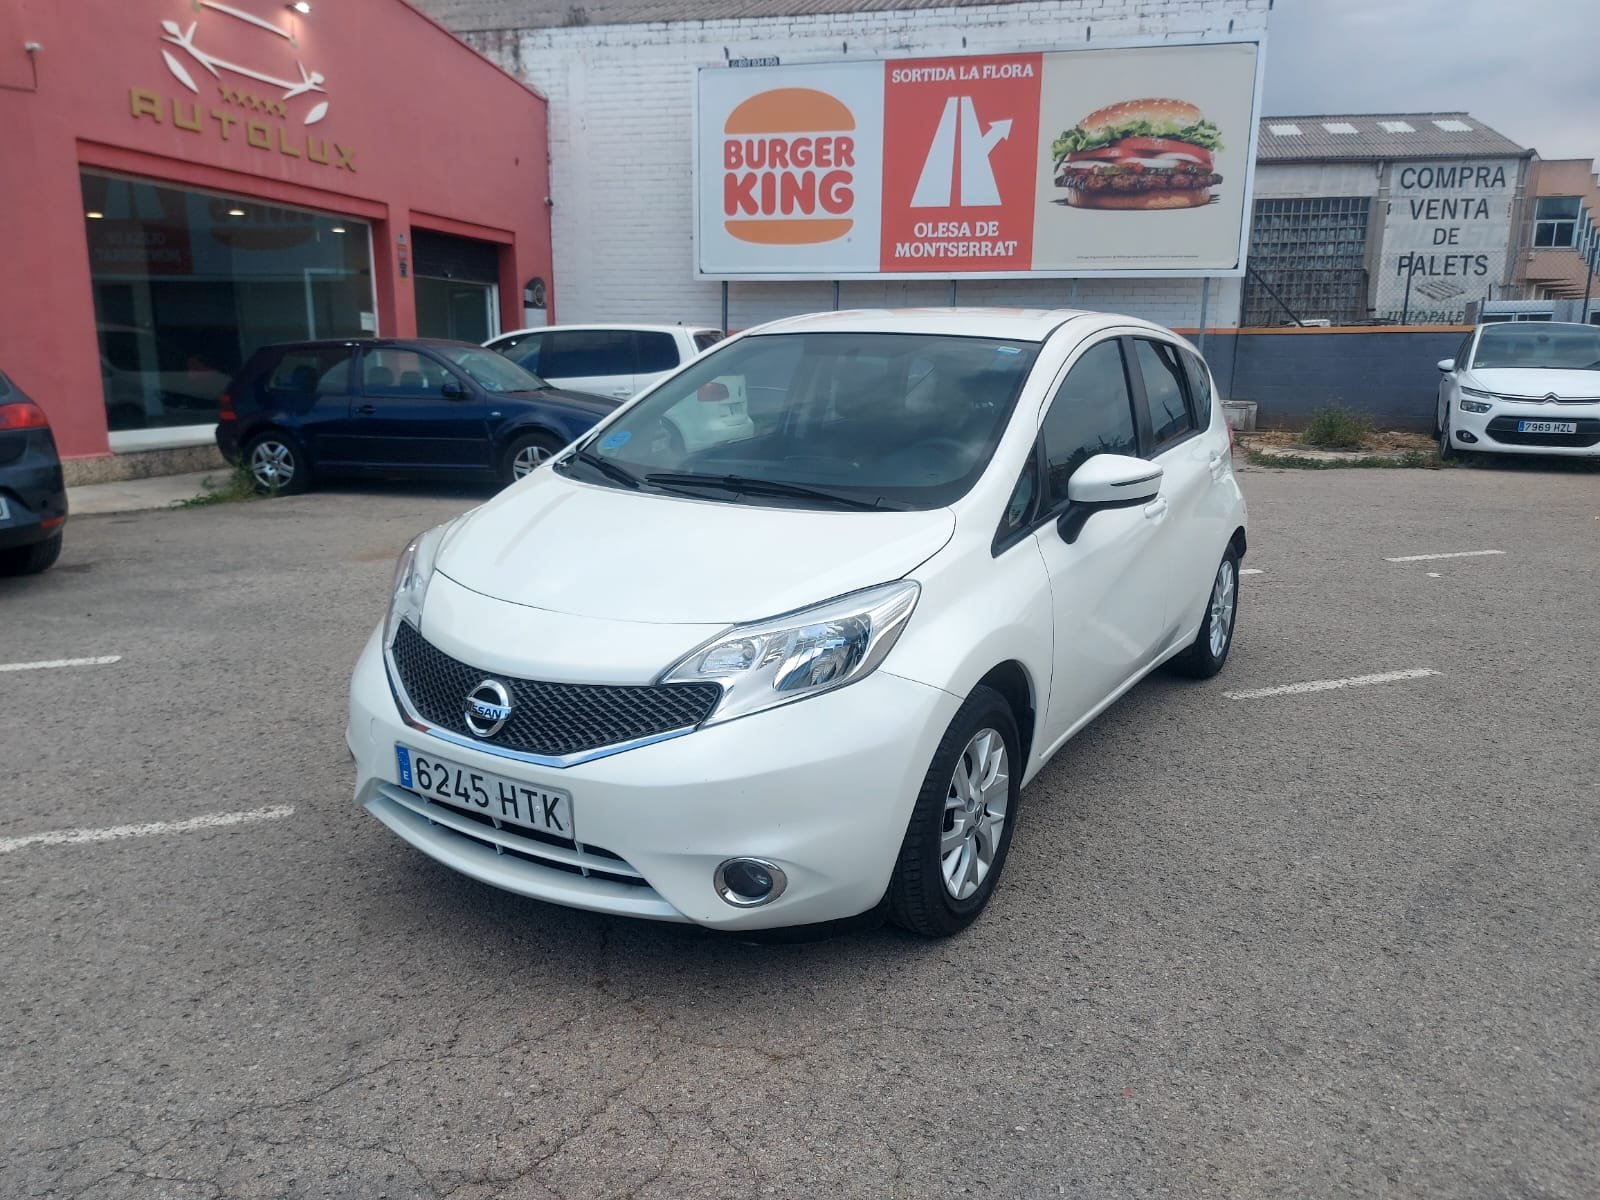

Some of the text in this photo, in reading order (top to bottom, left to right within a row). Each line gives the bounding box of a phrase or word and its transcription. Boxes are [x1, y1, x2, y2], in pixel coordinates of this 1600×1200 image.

[892, 64, 1034, 83] SORTIDA LA FLORA
[129, 86, 356, 172] AUTOLUX
[724, 136, 855, 170] BURGER
[1400, 166, 1506, 189] COMPRA
[724, 169, 855, 216] KING
[1410, 198, 1489, 220] VENTA
[914, 221, 999, 238] OLESA DE
[1432, 228, 1460, 245] DE
[895, 241, 1018, 258] MONTSERRAT
[1397, 254, 1489, 277] PALETS
[1525, 422, 1573, 433] 7969 HZL
[415, 757, 563, 831] 6245 HTK
